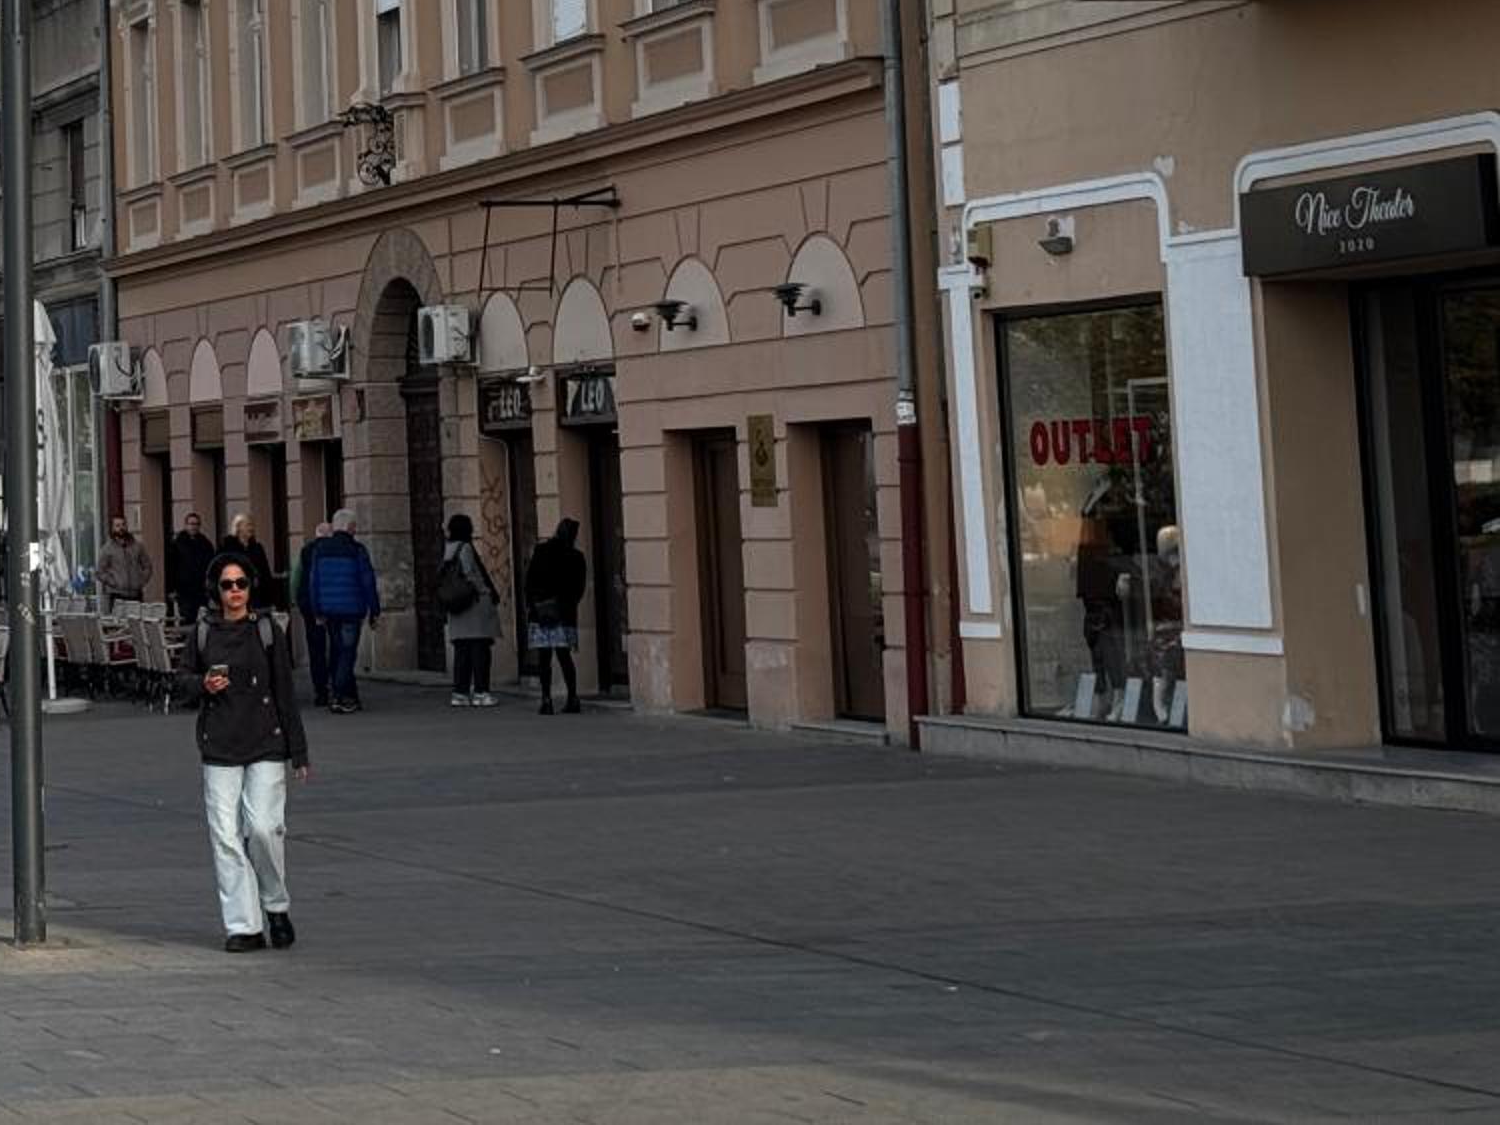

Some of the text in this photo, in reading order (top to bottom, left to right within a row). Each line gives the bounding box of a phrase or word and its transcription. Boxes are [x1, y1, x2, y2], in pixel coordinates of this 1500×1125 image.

[1295, 191, 1342, 236] Nice
[581, 377, 605, 413] LEO
[1030, 416, 1153, 466] OUTLET
